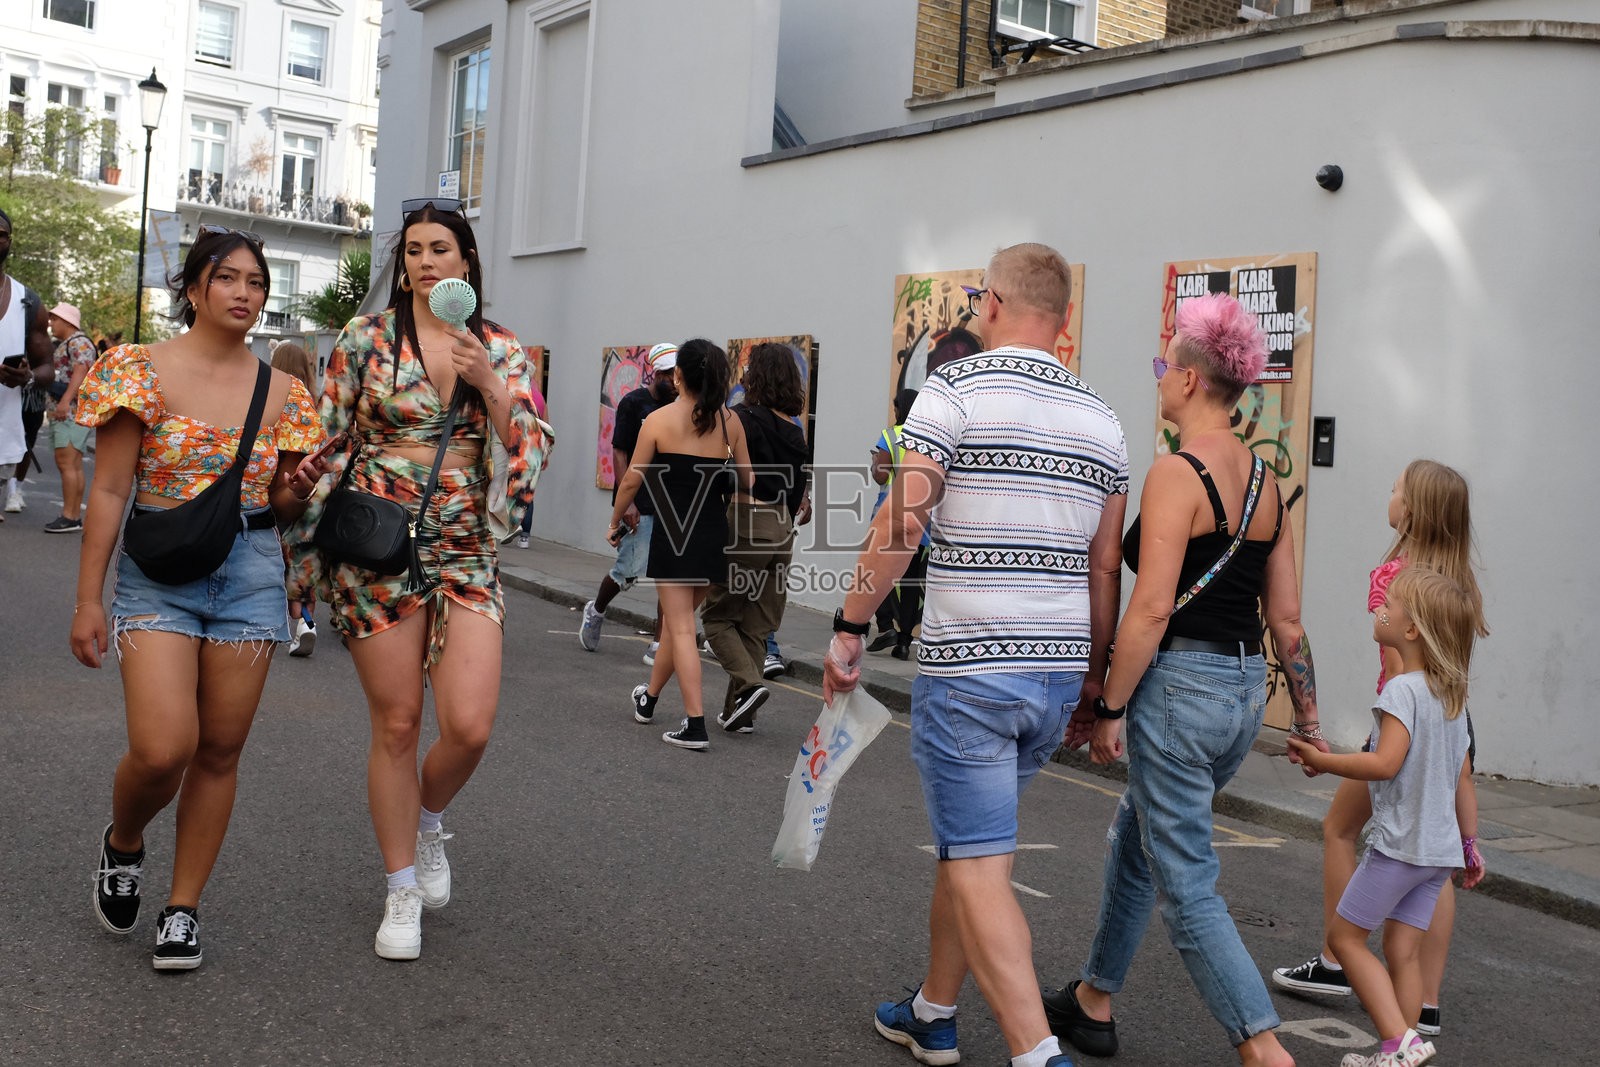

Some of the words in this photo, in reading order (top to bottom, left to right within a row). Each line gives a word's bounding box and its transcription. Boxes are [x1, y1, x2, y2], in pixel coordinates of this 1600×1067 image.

[1177, 275, 1209, 297] KARL
[1239, 269, 1275, 292] KARL
[1238, 291, 1278, 313] MARX
